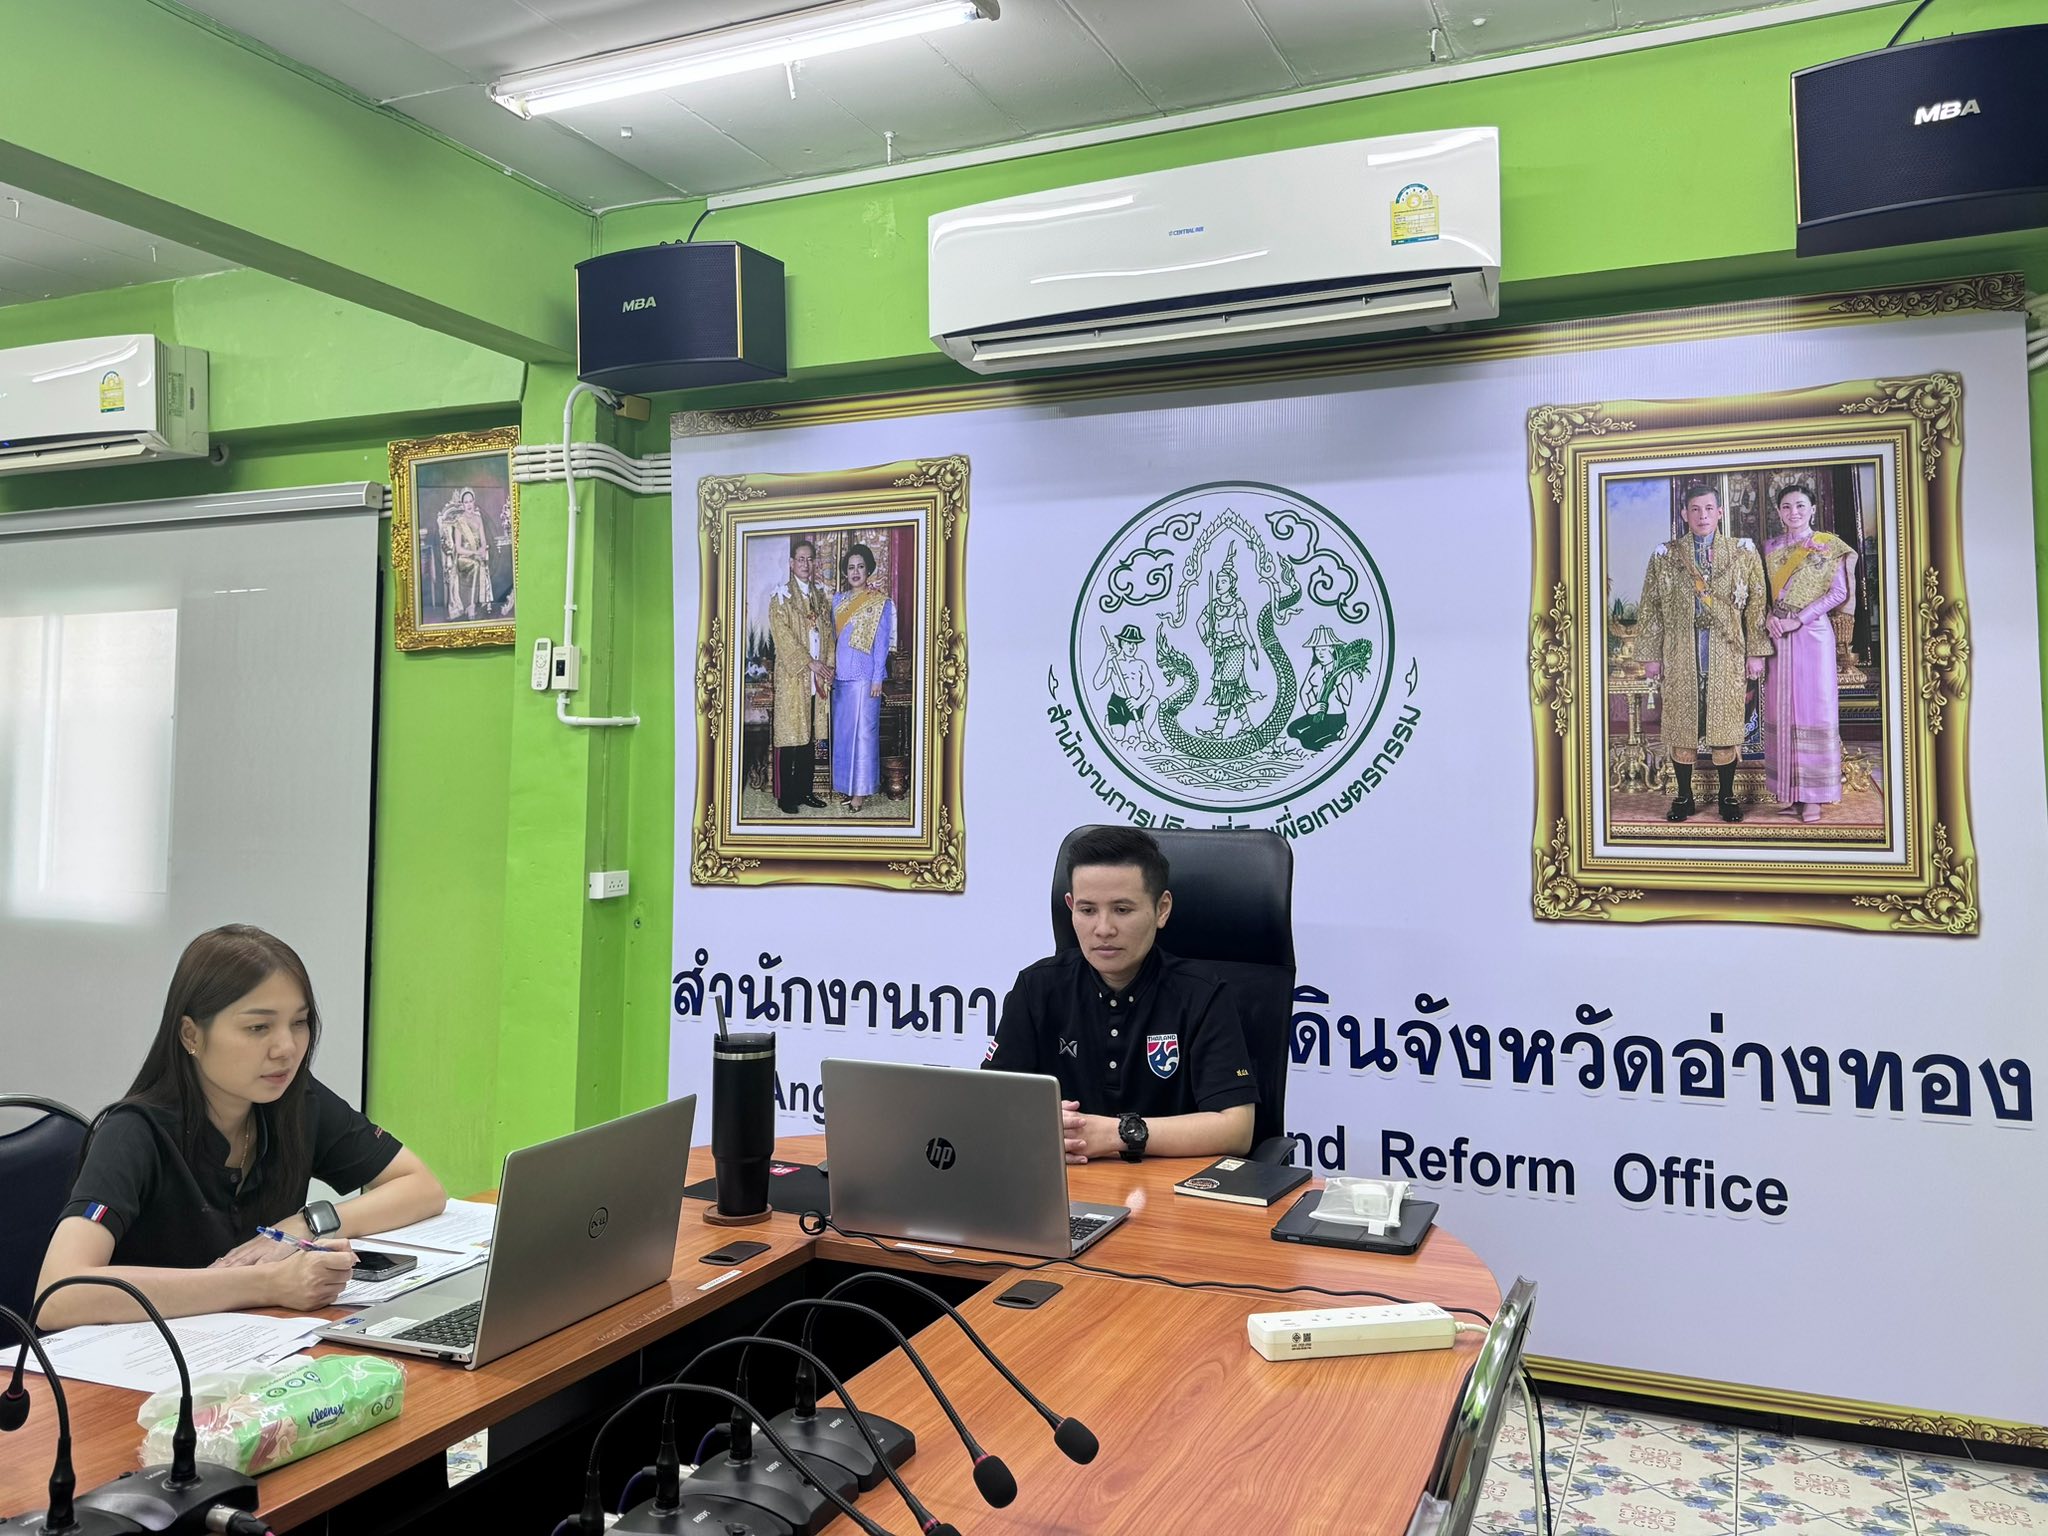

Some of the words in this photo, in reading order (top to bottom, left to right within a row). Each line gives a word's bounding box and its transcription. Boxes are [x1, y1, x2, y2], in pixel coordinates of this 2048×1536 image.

[1914, 99, 1981, 126] MBA
[622, 296, 657, 313] MBA
[929, 1137, 953, 1170] hp
[1381, 1129, 1576, 1196] Reform
[1613, 1153, 1789, 1217] Office
[307, 1403, 346, 1428] Kleenex
